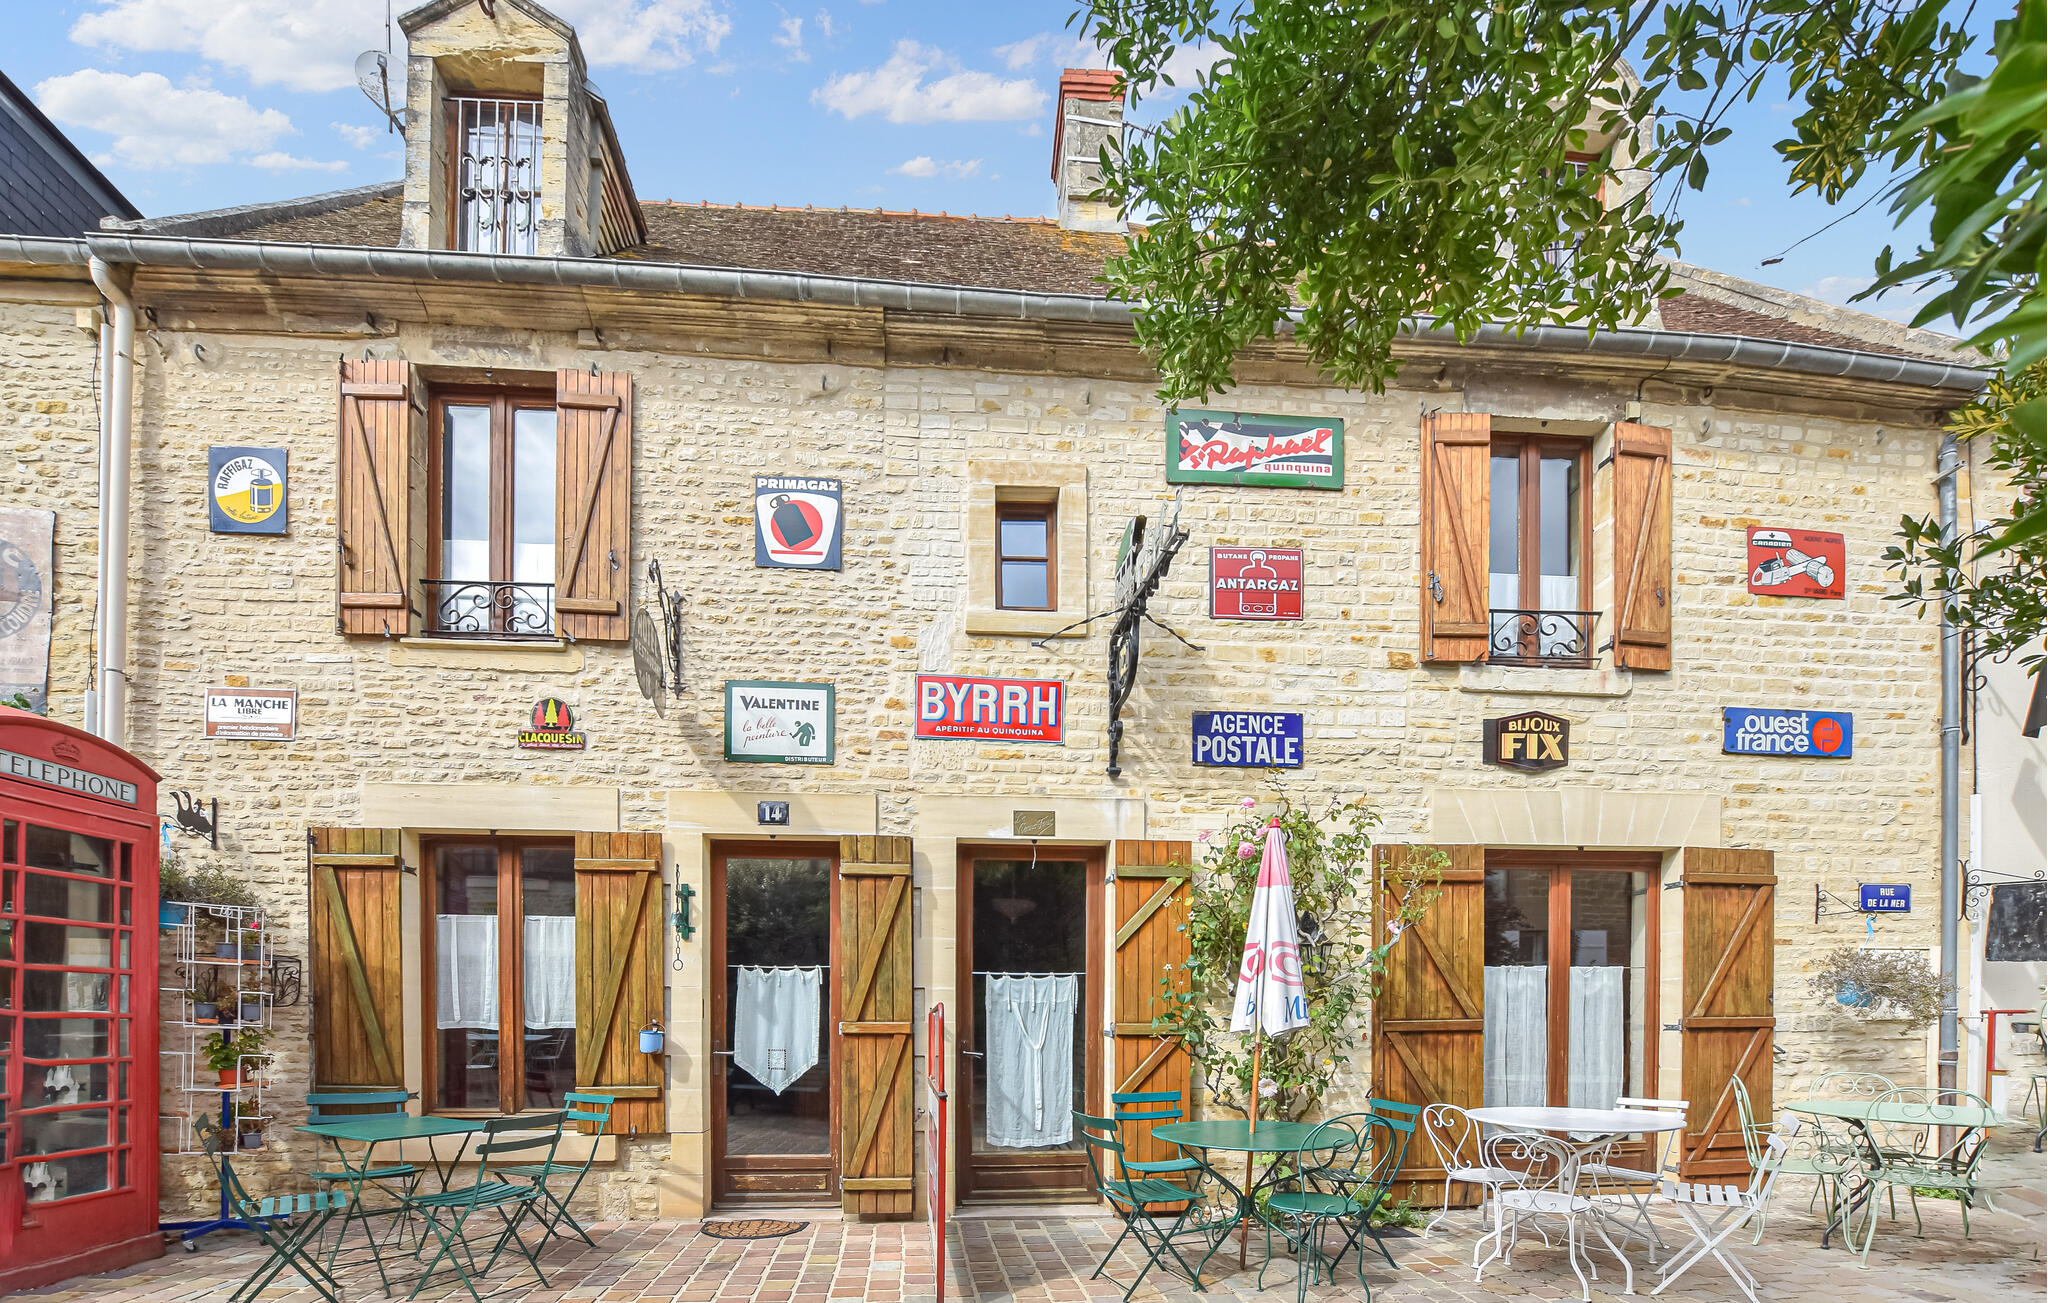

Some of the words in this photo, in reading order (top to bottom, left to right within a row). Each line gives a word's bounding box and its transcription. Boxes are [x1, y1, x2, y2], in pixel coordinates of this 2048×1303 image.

[217, 459, 253, 490] RAFFIGAZ
[1264, 463, 1331, 474] quinquina
[757, 478, 838, 491] PRIMAGAZ
[1216, 578, 1299, 591] ANTARGAZ
[211, 697, 227, 707] LA
[234, 698, 289, 709] MANCHE
[740, 695, 819, 711] VALENTINE
[921, 681, 1058, 727] BYRRH
[742, 720, 752, 732] la
[756, 716, 776, 730] belle
[935, 725, 975, 733] APERITIF
[992, 727, 1044, 736] QUINQUINA
[1210, 714, 1285, 735] AGENCE
[1508, 717, 1560, 732] BIJOUX
[1744, 712, 1809, 734] ouest
[743, 729, 787, 748] peinture
[1501, 732, 1564, 760] FIX
[1736, 728, 1809, 752] france
[1197, 735, 1299, 764] POSTALE
[765, 805, 782, 820] 14
[1880, 887, 1895, 896] RUE
[1867, 898, 1878, 907] DE
[1879, 898, 1889, 907] LA
[1890, 899, 1906, 908] MER
